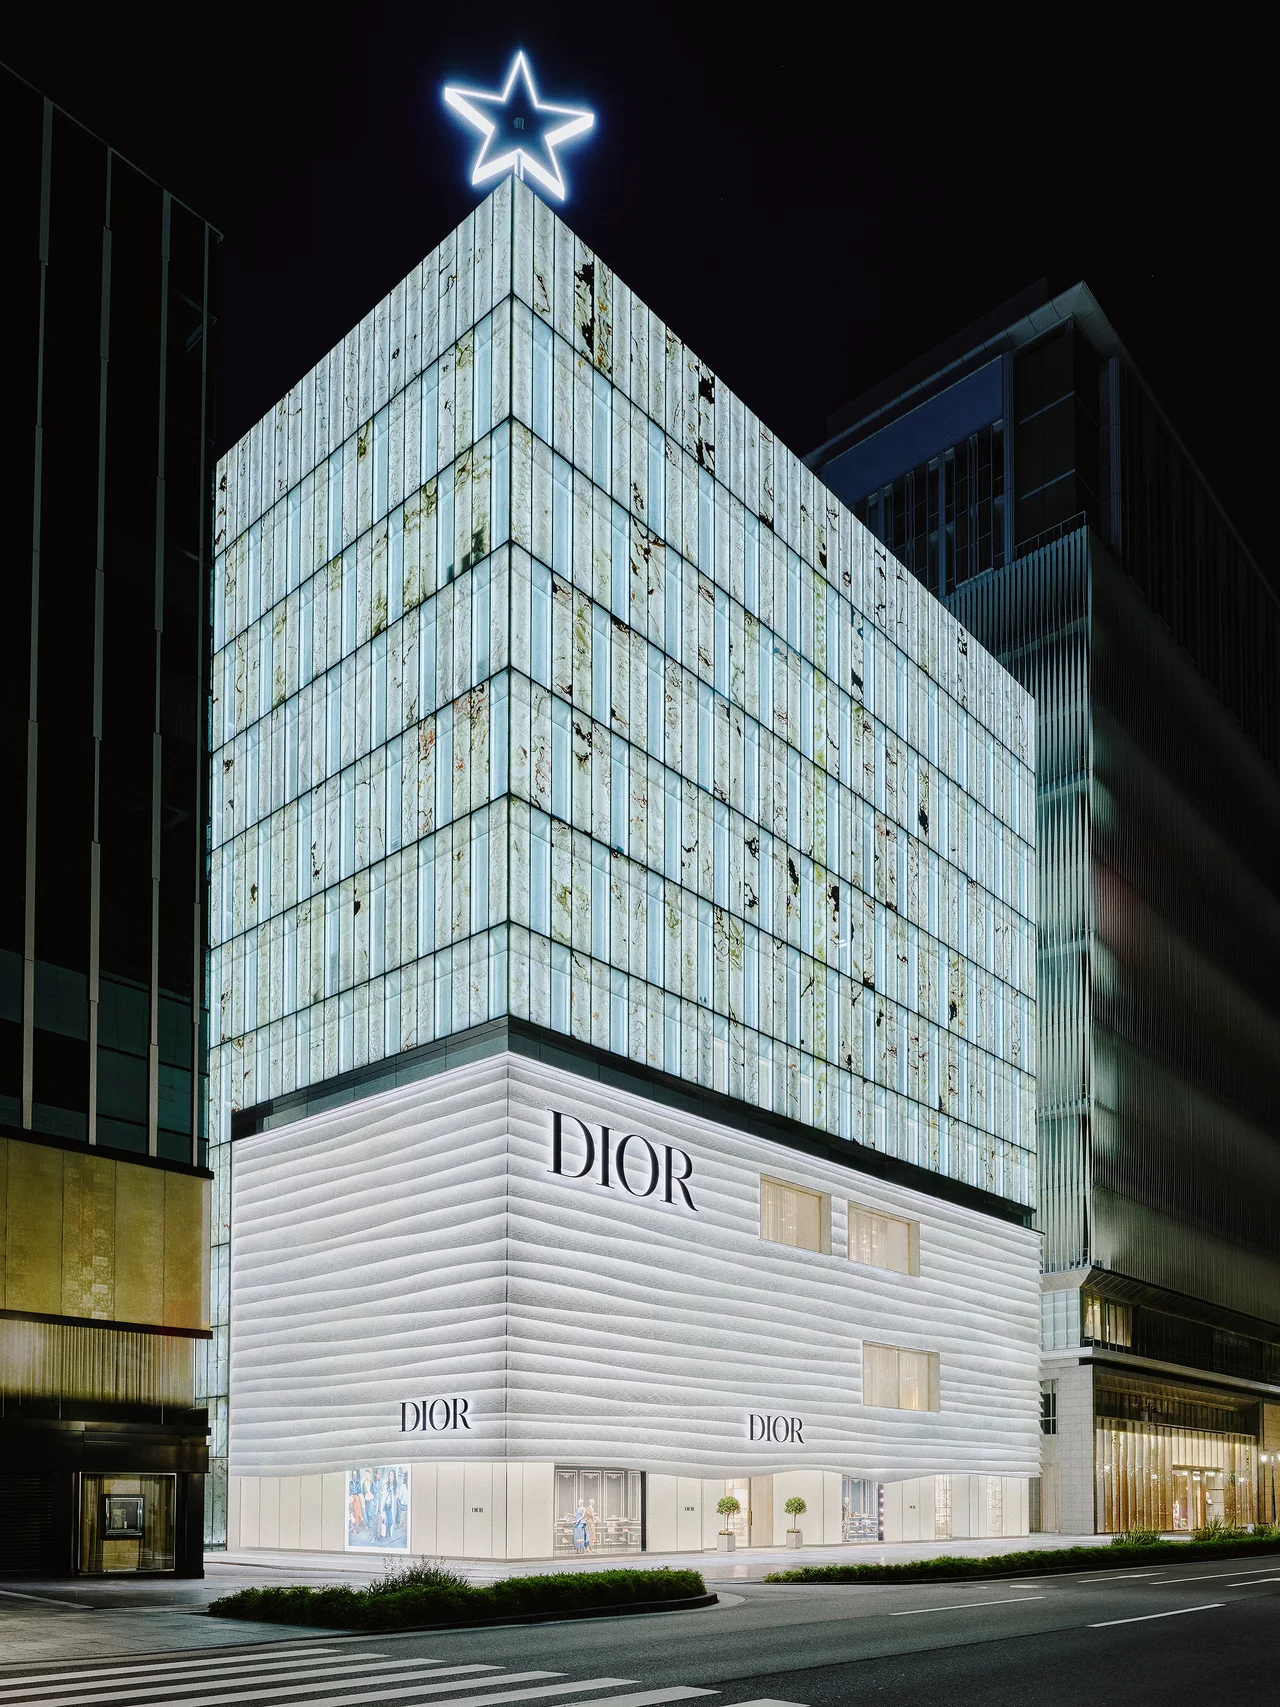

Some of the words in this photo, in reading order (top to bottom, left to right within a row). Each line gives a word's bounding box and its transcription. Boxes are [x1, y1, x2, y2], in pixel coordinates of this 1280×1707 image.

[546, 1108, 699, 1212] DIOR
[399, 1397, 472, 1433] DIOR
[748, 1413, 805, 1444] DIOR
